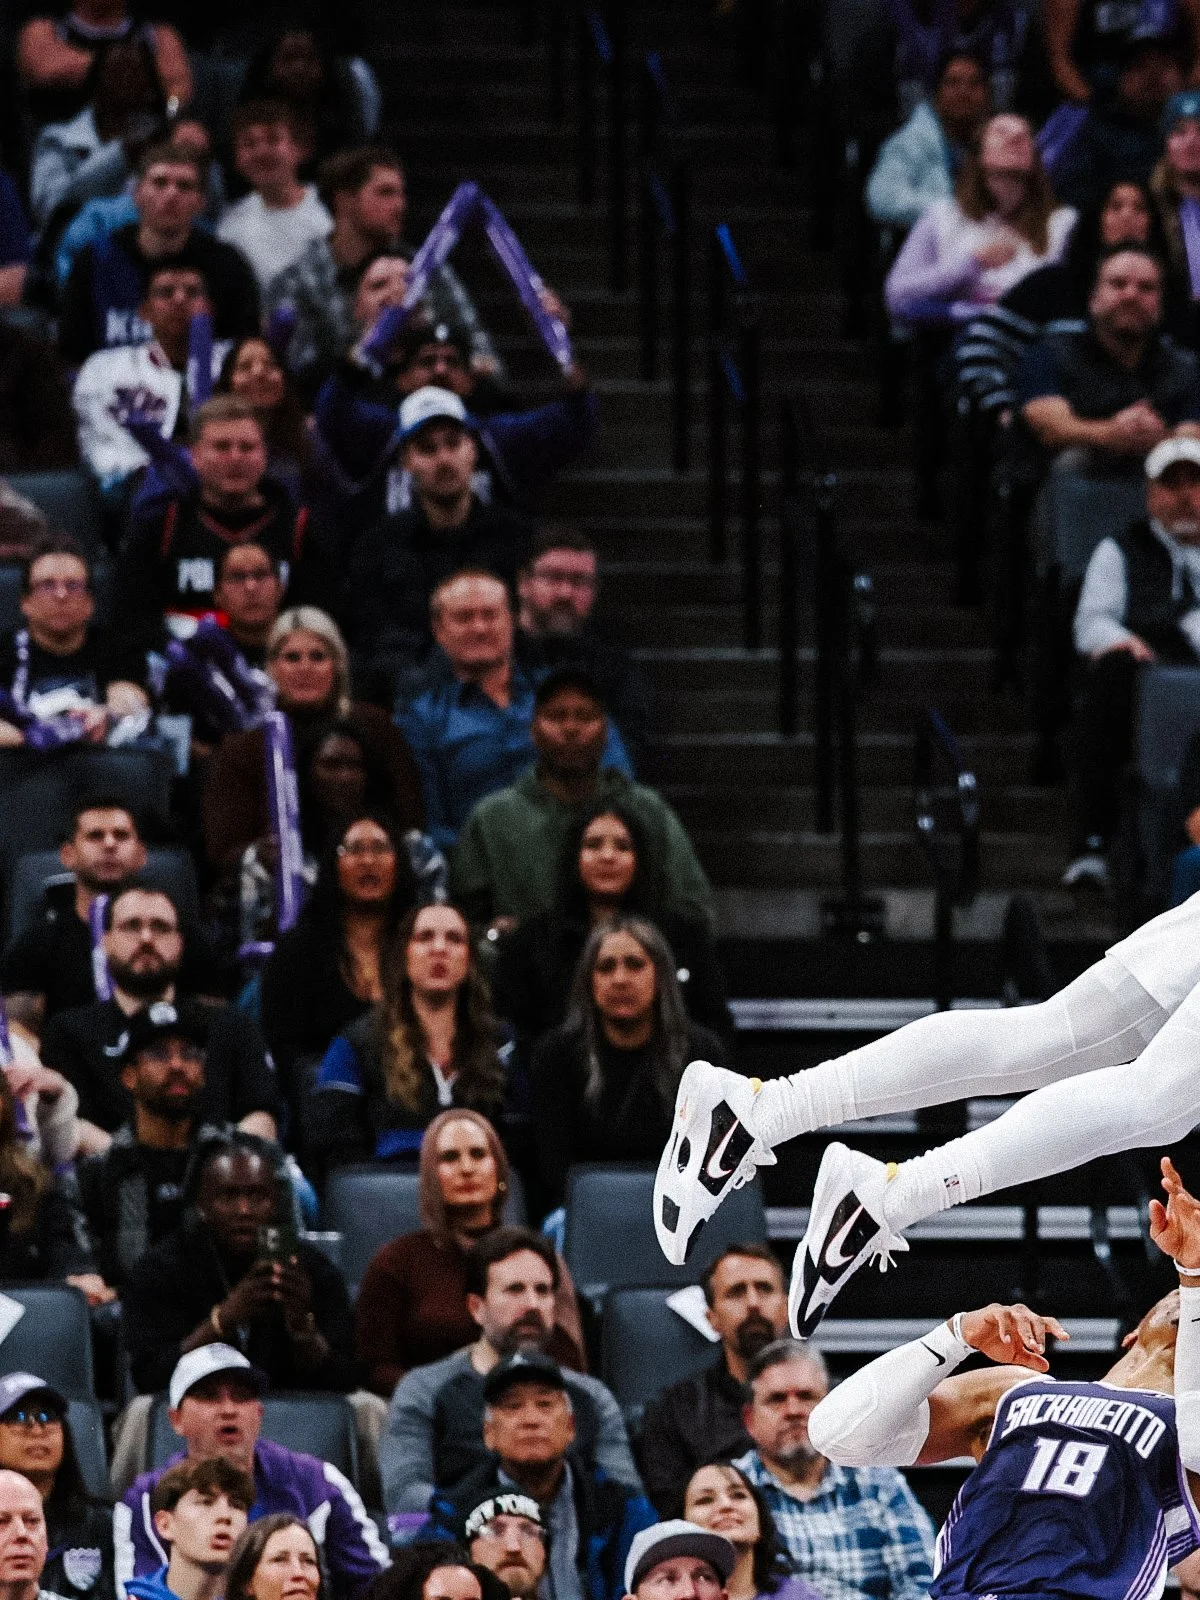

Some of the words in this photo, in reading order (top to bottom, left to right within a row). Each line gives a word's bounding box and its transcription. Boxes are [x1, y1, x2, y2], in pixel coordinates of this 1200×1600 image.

[1000, 1393, 1167, 1460] SACRAMENTO
[1020, 1436, 1110, 1498] 18
[464, 1498, 495, 1538] NEW
[495, 1493, 542, 1522] YORK
